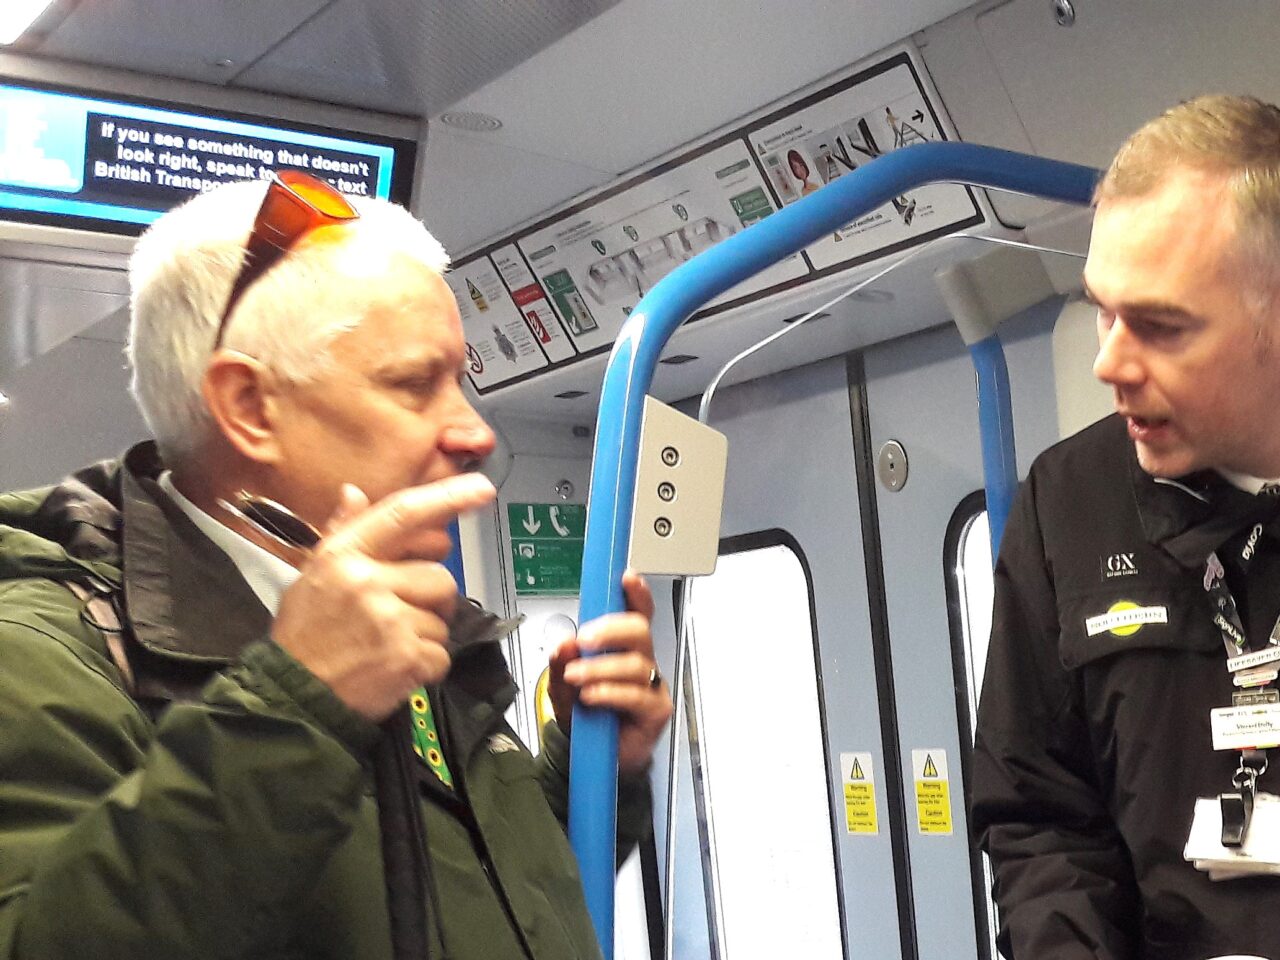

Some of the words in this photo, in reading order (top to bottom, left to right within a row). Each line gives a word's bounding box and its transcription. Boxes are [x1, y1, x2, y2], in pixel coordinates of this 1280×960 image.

[94, 160, 152, 183] British
[101, 122, 114, 139] If
[117, 127, 150, 146] you
[154, 132, 184, 148] see
[187, 135, 274, 165] something
[277, 149, 309, 168] that
[311, 152, 370, 177] doesn't
[117, 145, 155, 164] look
[158, 148, 202, 173] right,
[206, 158, 257, 180] speak
[259, 165, 279, 182] to
[337, 176, 367, 195] text
